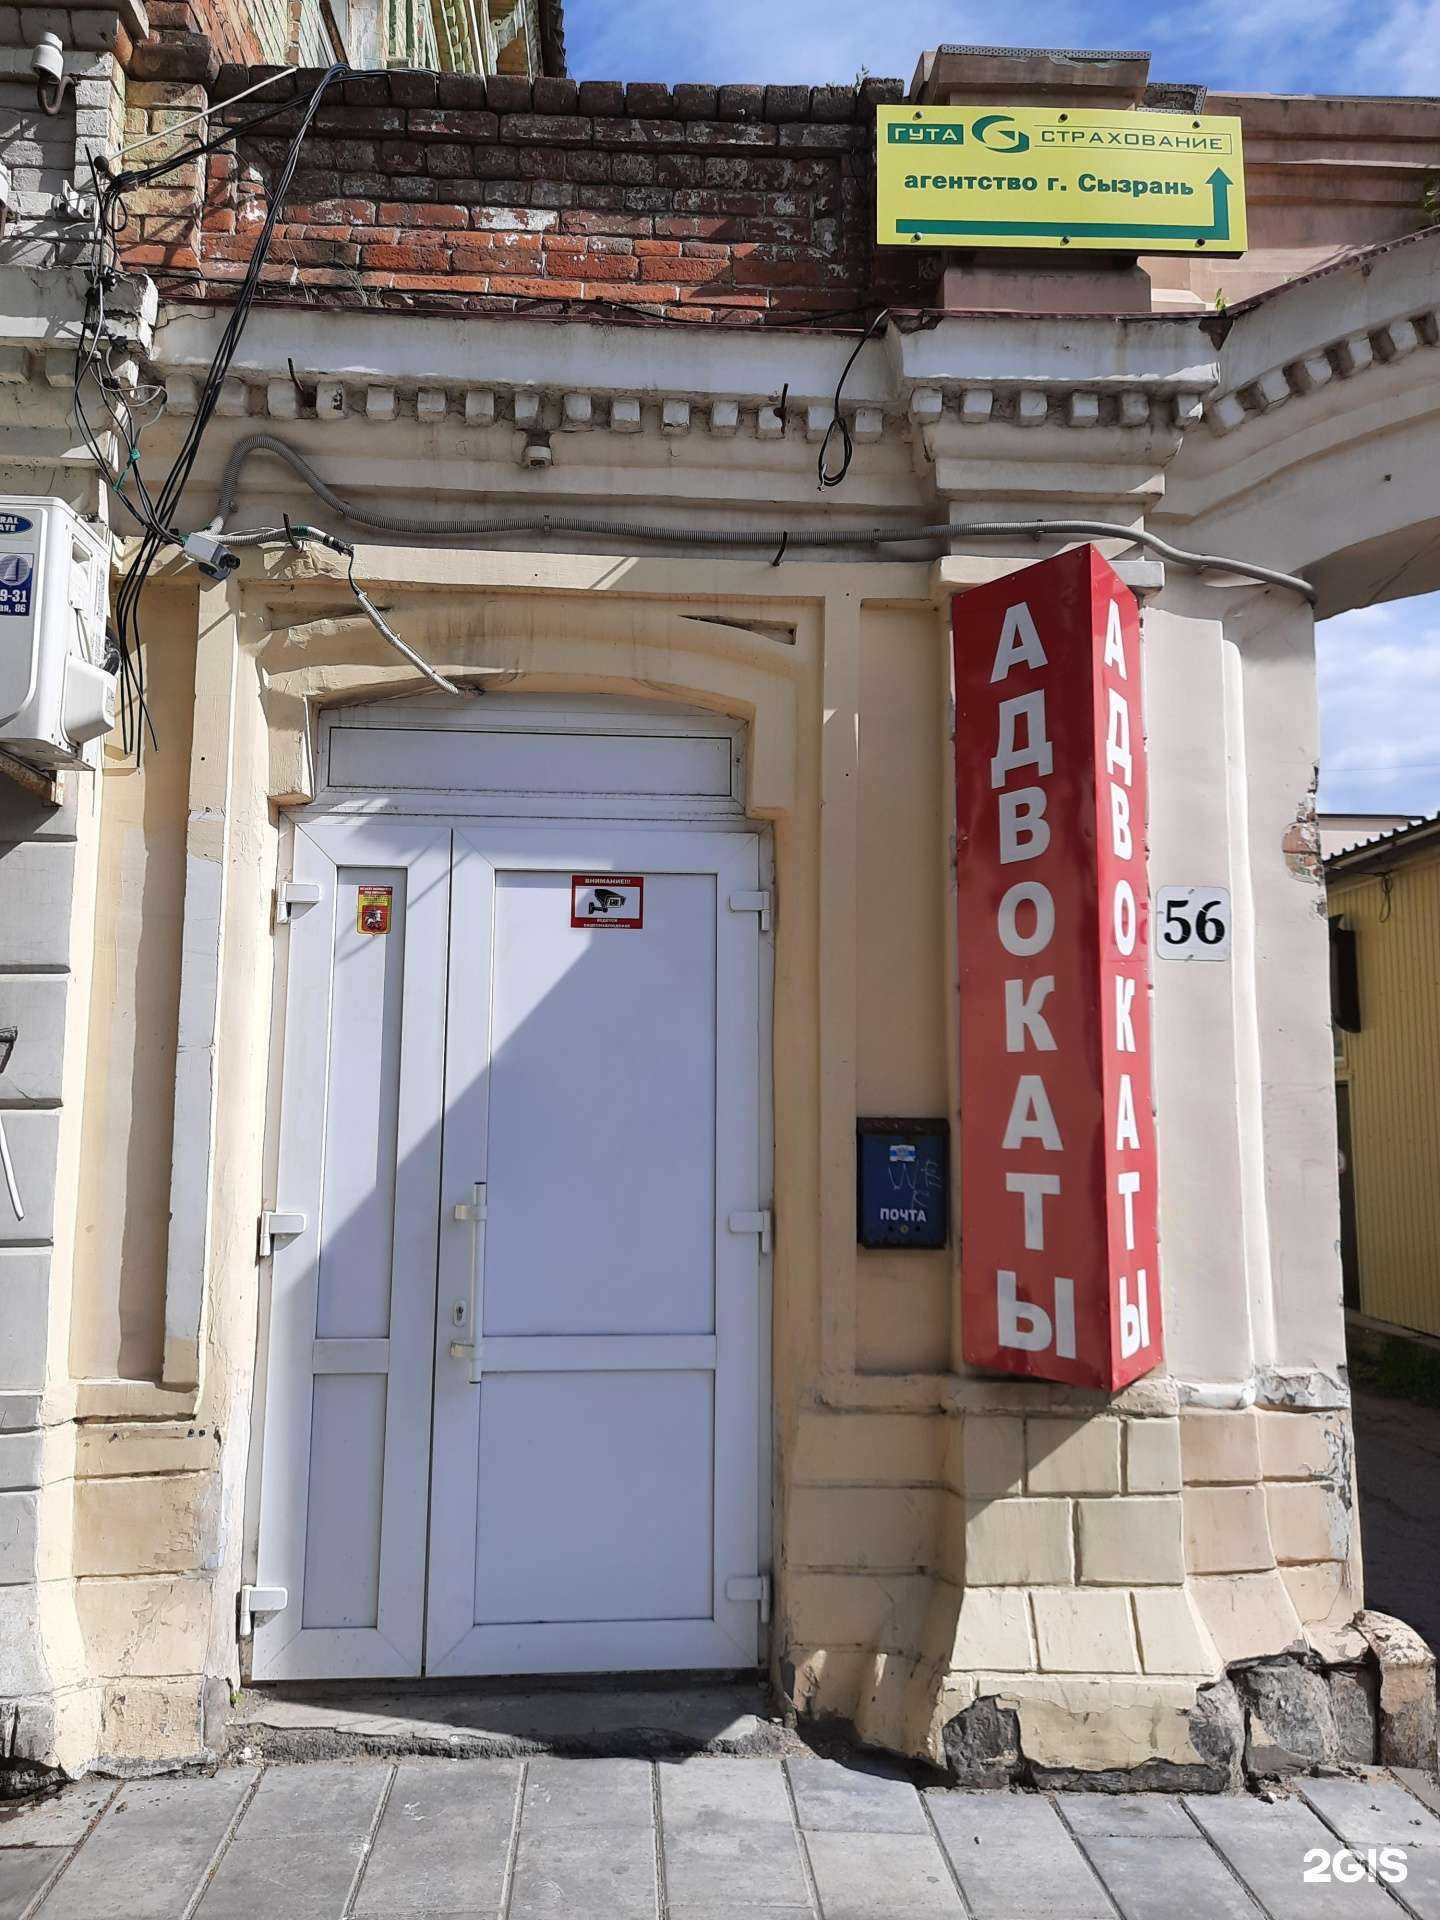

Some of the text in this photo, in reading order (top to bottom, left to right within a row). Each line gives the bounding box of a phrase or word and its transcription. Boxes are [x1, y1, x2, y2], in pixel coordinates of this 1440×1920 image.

[893, 126, 1224, 150] ГУТА СТРАХОВАНИЕ
[904, 173, 1194, 197] агентство г. Сызрань
[1163, 900, 1226, 946] 56
[990, 601, 1077, 1359] АДВОКАТЫ
[1104, 598, 1150, 1359] АДВОКАТЫ
[880, 1207, 927, 1223] ПОЧТА
